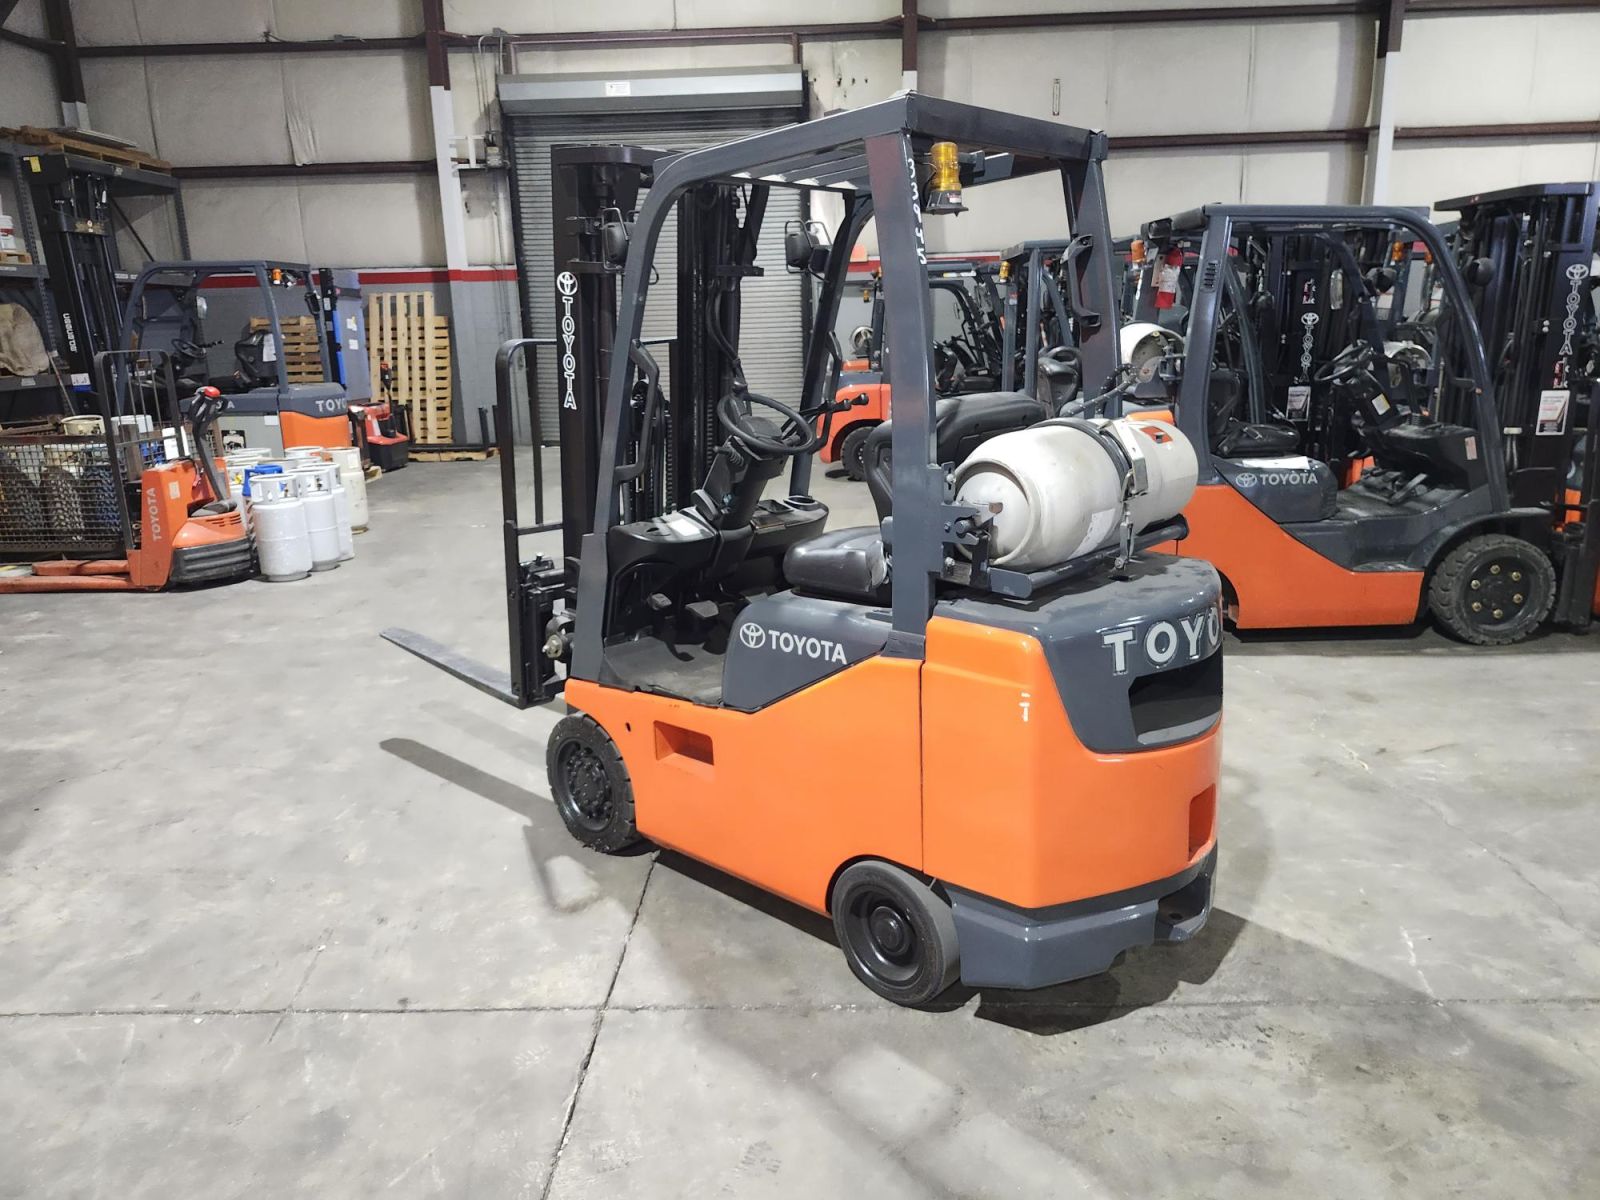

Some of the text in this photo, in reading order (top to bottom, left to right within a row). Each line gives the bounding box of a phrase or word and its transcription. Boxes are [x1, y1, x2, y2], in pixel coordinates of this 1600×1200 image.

[1559, 280, 1581, 355] TOYOTA
[562, 296, 577, 410] TOYOTA
[1300, 325, 1313, 382] TOYOTA
[1260, 472, 1318, 486] TOYOTA
[146, 487, 162, 541] TOYOTA
[768, 629, 848, 665] TOYOTA
[1102, 606, 1221, 675] TOYO
